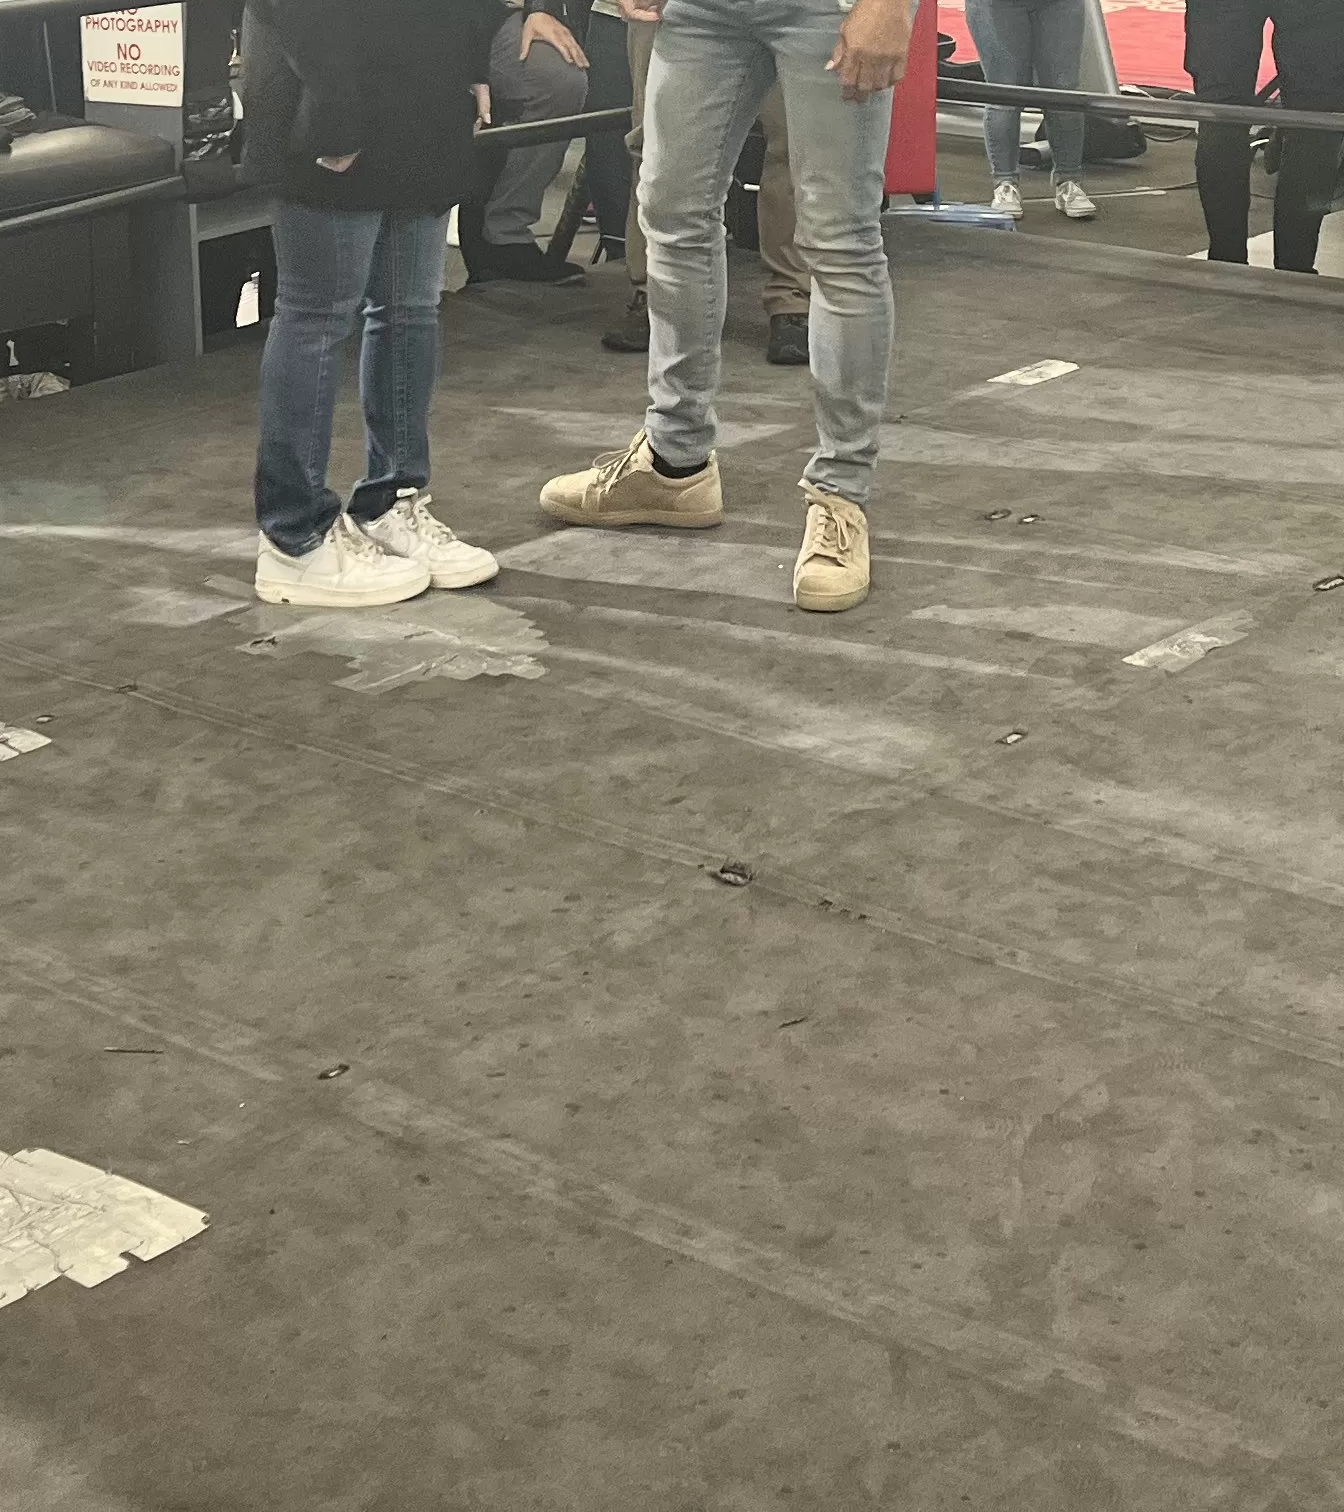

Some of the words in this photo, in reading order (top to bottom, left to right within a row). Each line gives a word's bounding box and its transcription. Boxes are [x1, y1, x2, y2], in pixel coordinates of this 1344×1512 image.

[85, 16, 179, 34] PHOTOGRAPHY
[117, 43, 141, 61] NO
[87, 60, 117, 73] VIDEO
[120, 62, 181, 77] RECORDING
[90, 78, 100, 87] OF
[102, 79, 117, 89] ANY
[120, 80, 137, 90] KIND
